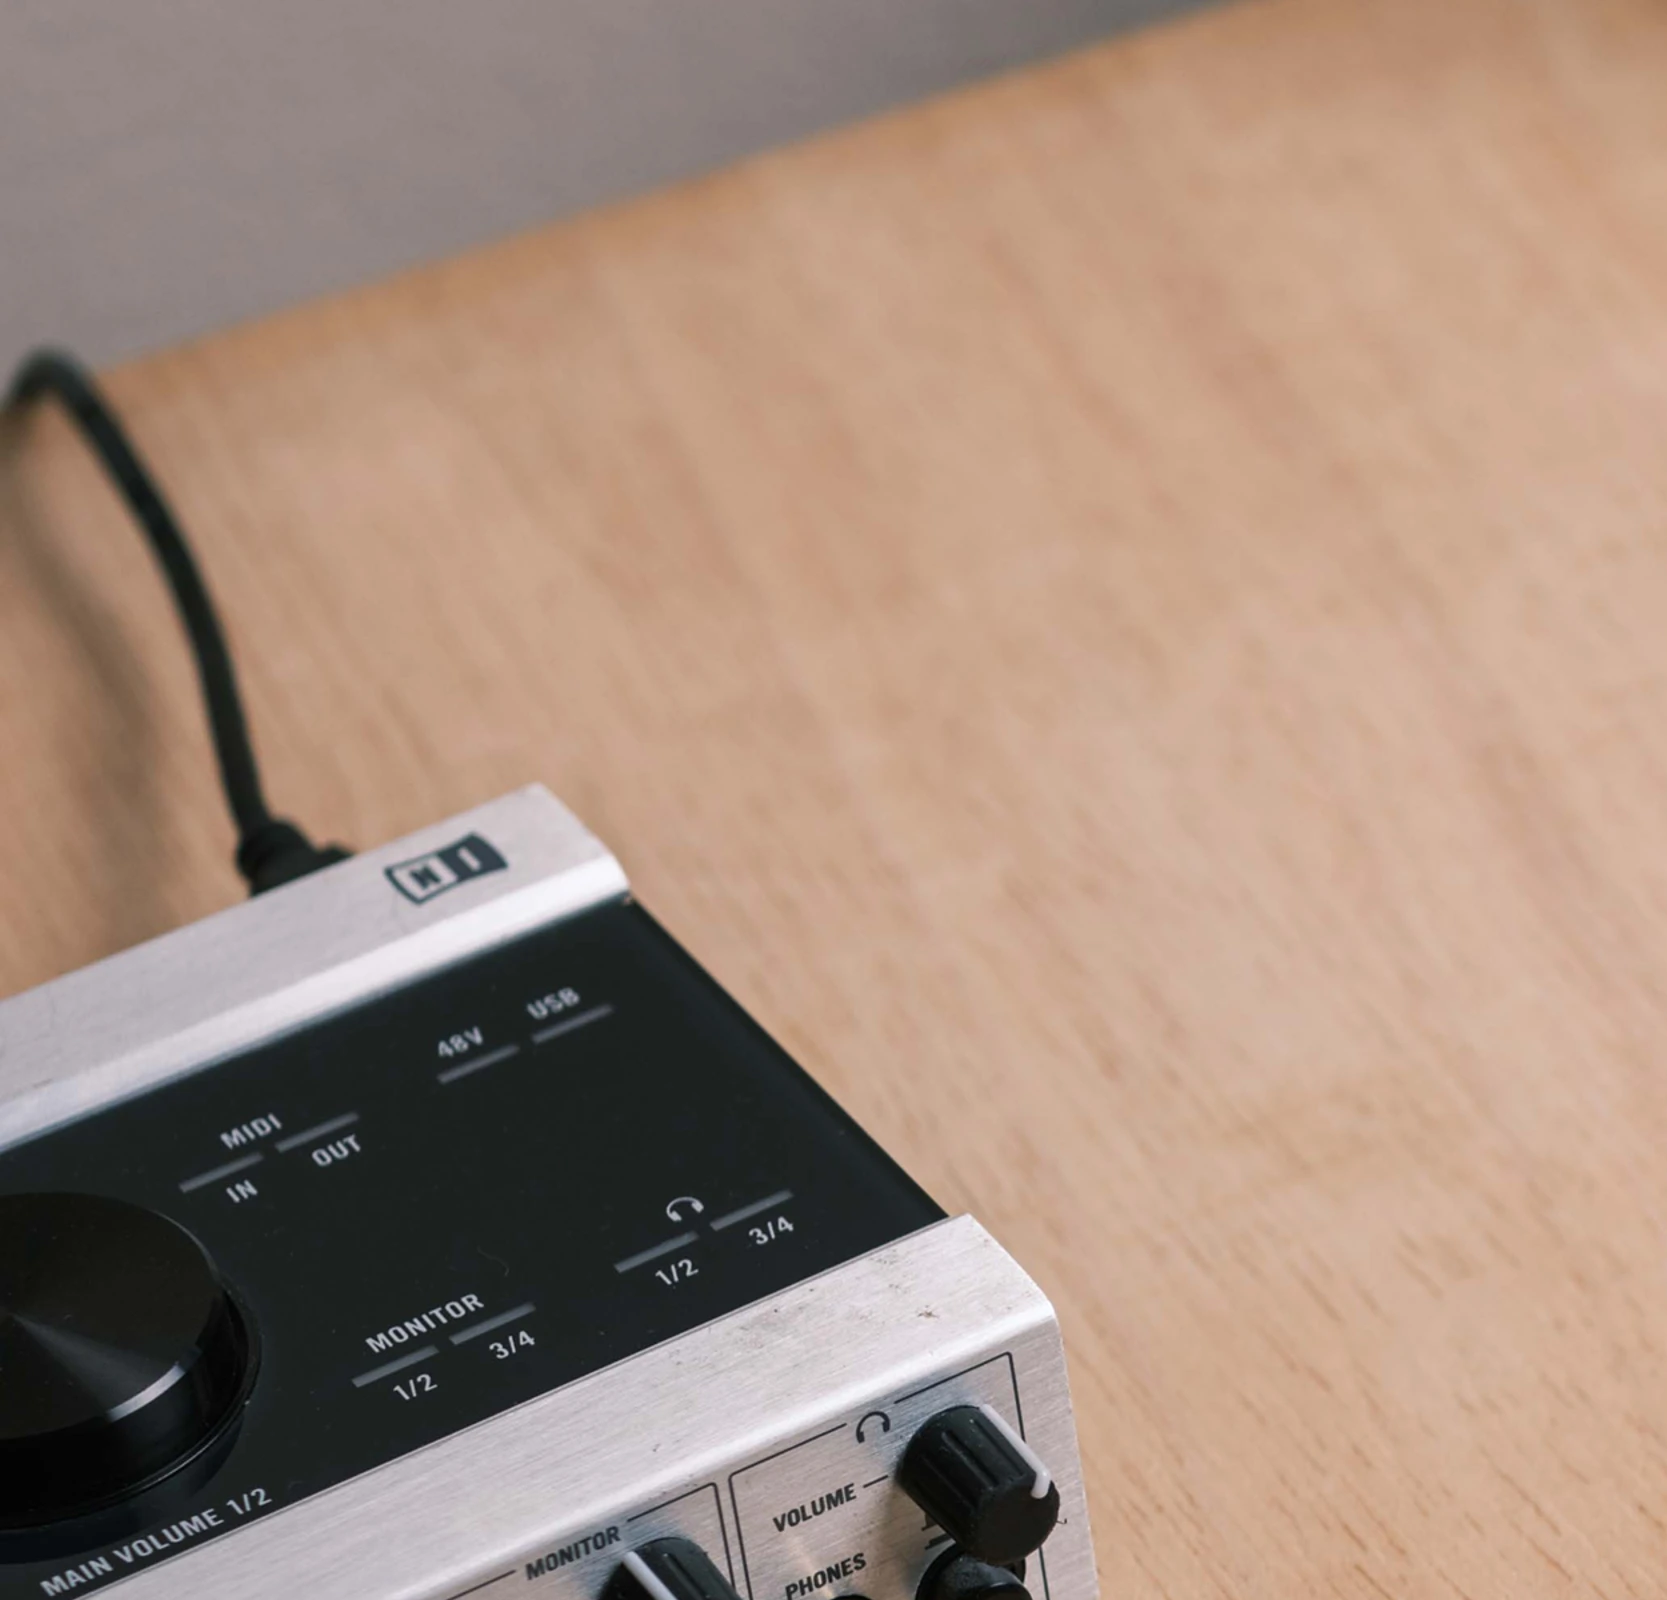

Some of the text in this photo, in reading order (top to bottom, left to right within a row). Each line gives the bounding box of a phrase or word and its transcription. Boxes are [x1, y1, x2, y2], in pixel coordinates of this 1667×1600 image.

[526, 986, 581, 1021] USB
[436, 1025, 485, 1058] 48V
[219, 1112, 284, 1150] MIDI
[311, 1133, 362, 1167] OUT
[225, 1179, 259, 1204] IN
[747, 1215, 795, 1246] 3/4
[655, 1258, 700, 1287] 1/2
[365, 1292, 485, 1354] MONITOR
[488, 1329, 536, 1360] 3/4
[393, 1372, 438, 1402] 1/2
[772, 1482, 857, 1533] VOLUME
[39, 1487, 273, 1597] MAIN VOLUME 1/2
[525, 1525, 621, 1581] MONITOR
